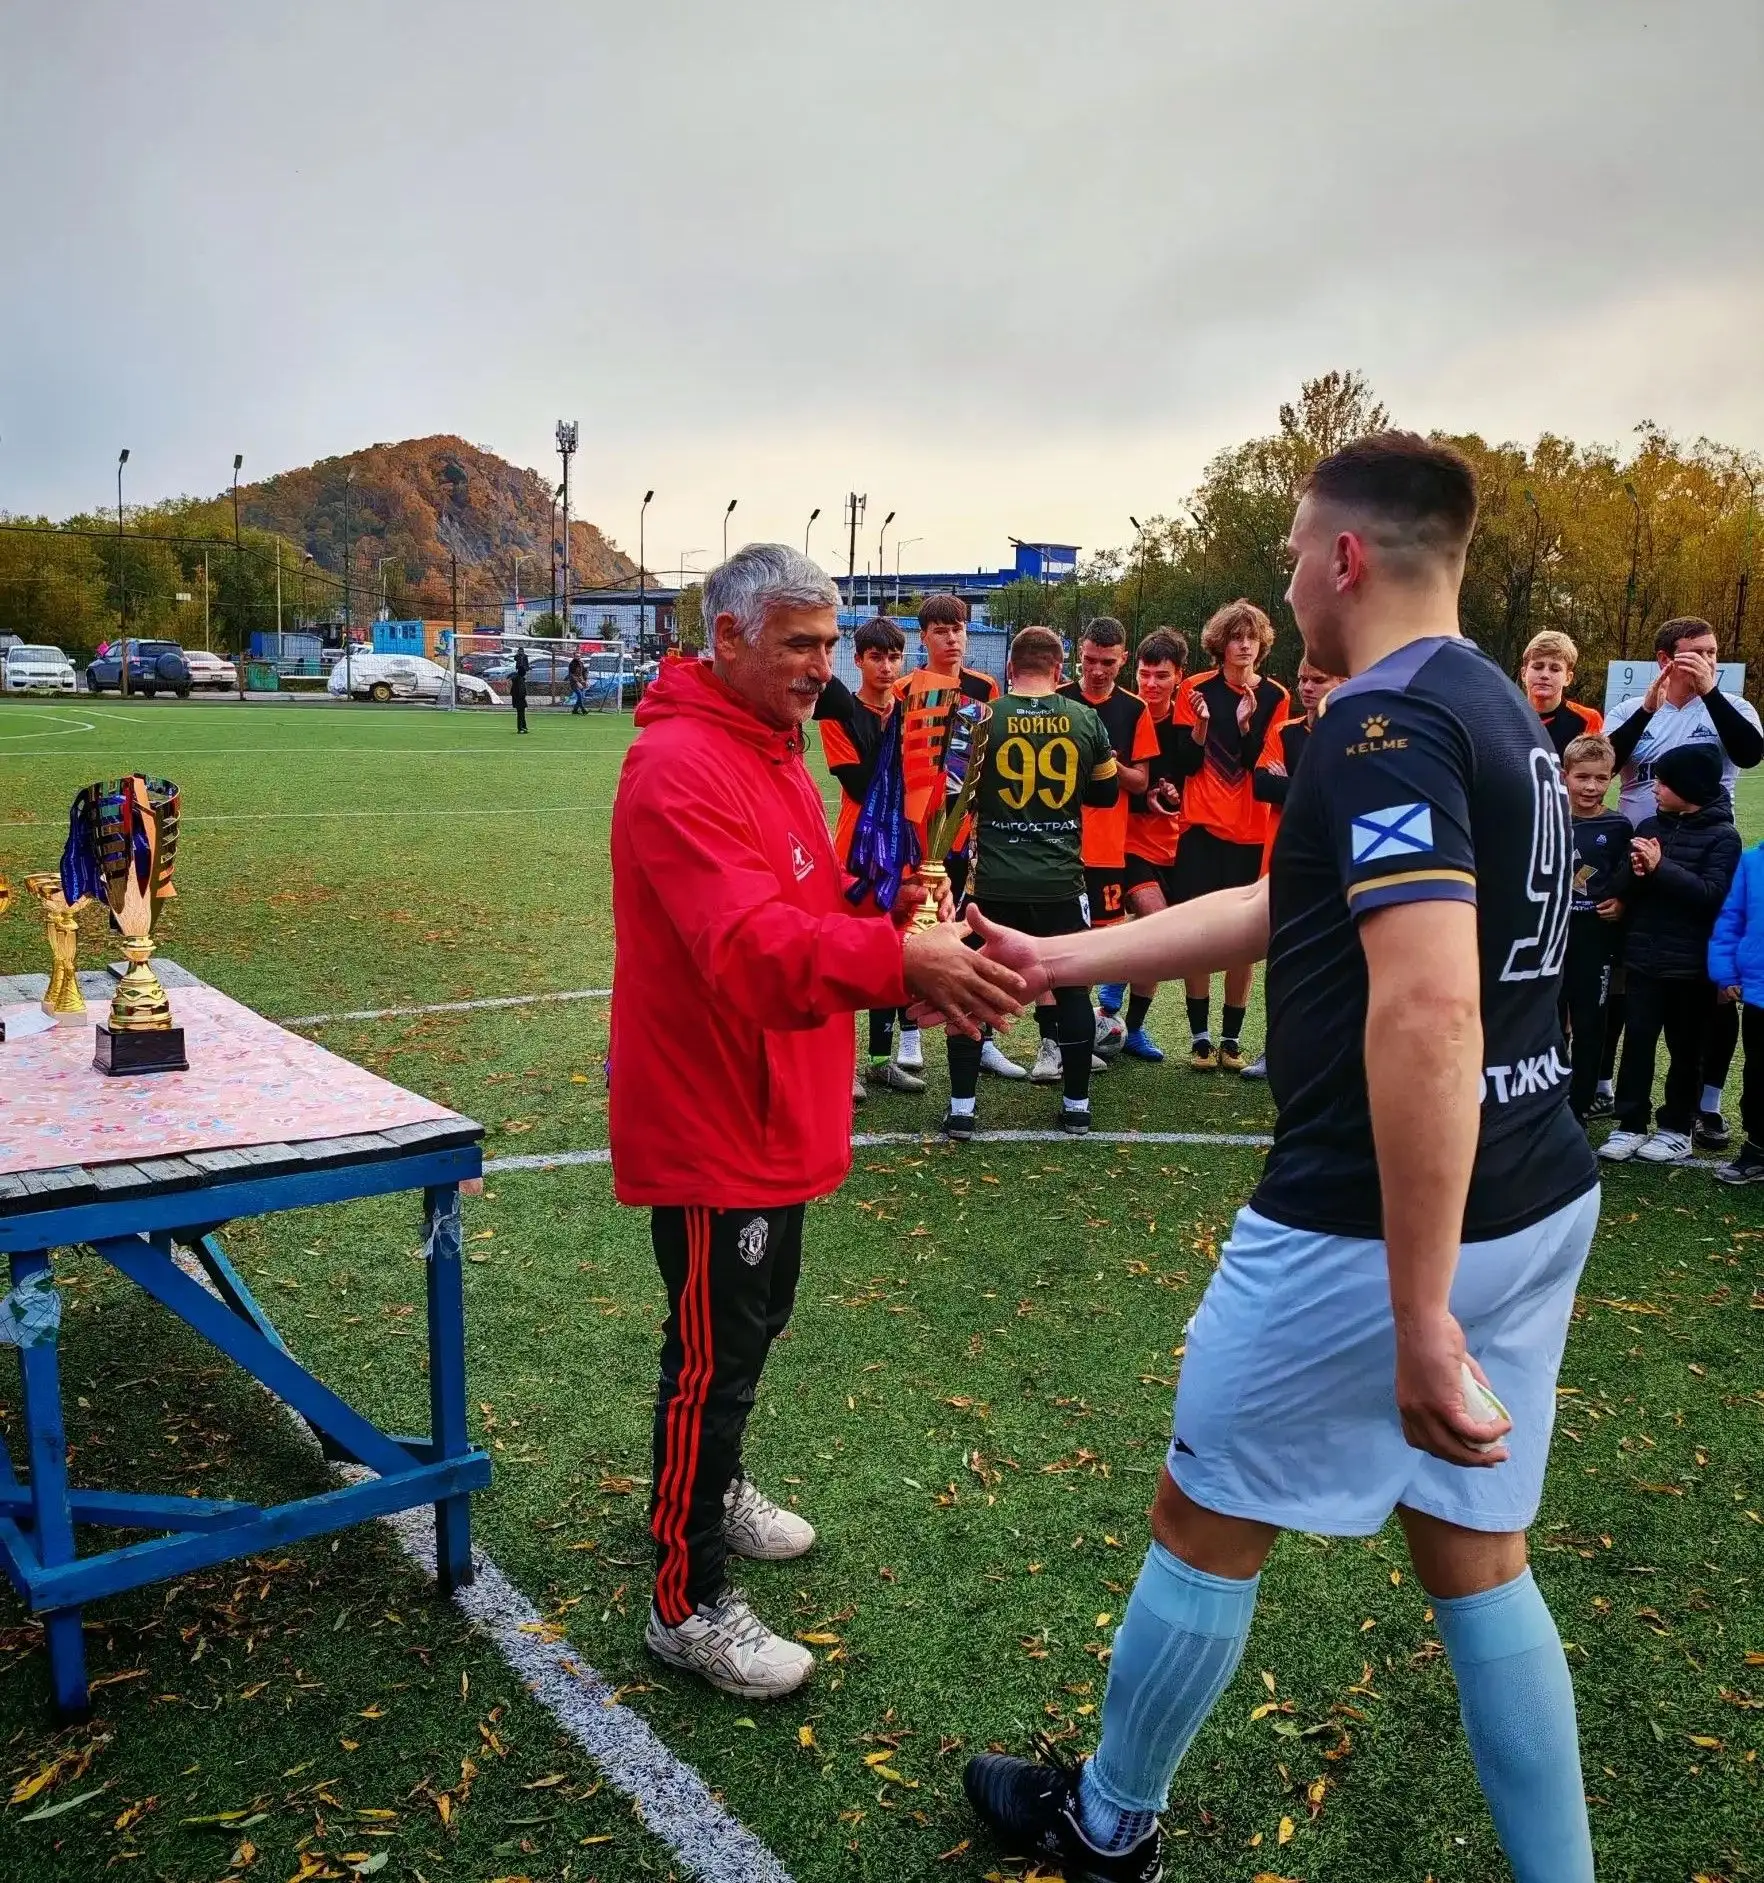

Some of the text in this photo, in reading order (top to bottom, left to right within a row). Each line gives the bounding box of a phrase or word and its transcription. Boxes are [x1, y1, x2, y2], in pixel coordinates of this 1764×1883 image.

[1623, 667, 1634, 686] 9
[1007, 715, 1070, 734] БОЙКО
[1345, 738, 1408, 756] KELME
[995, 737, 1079, 810] 99
[1103, 884, 1121, 911] 12
